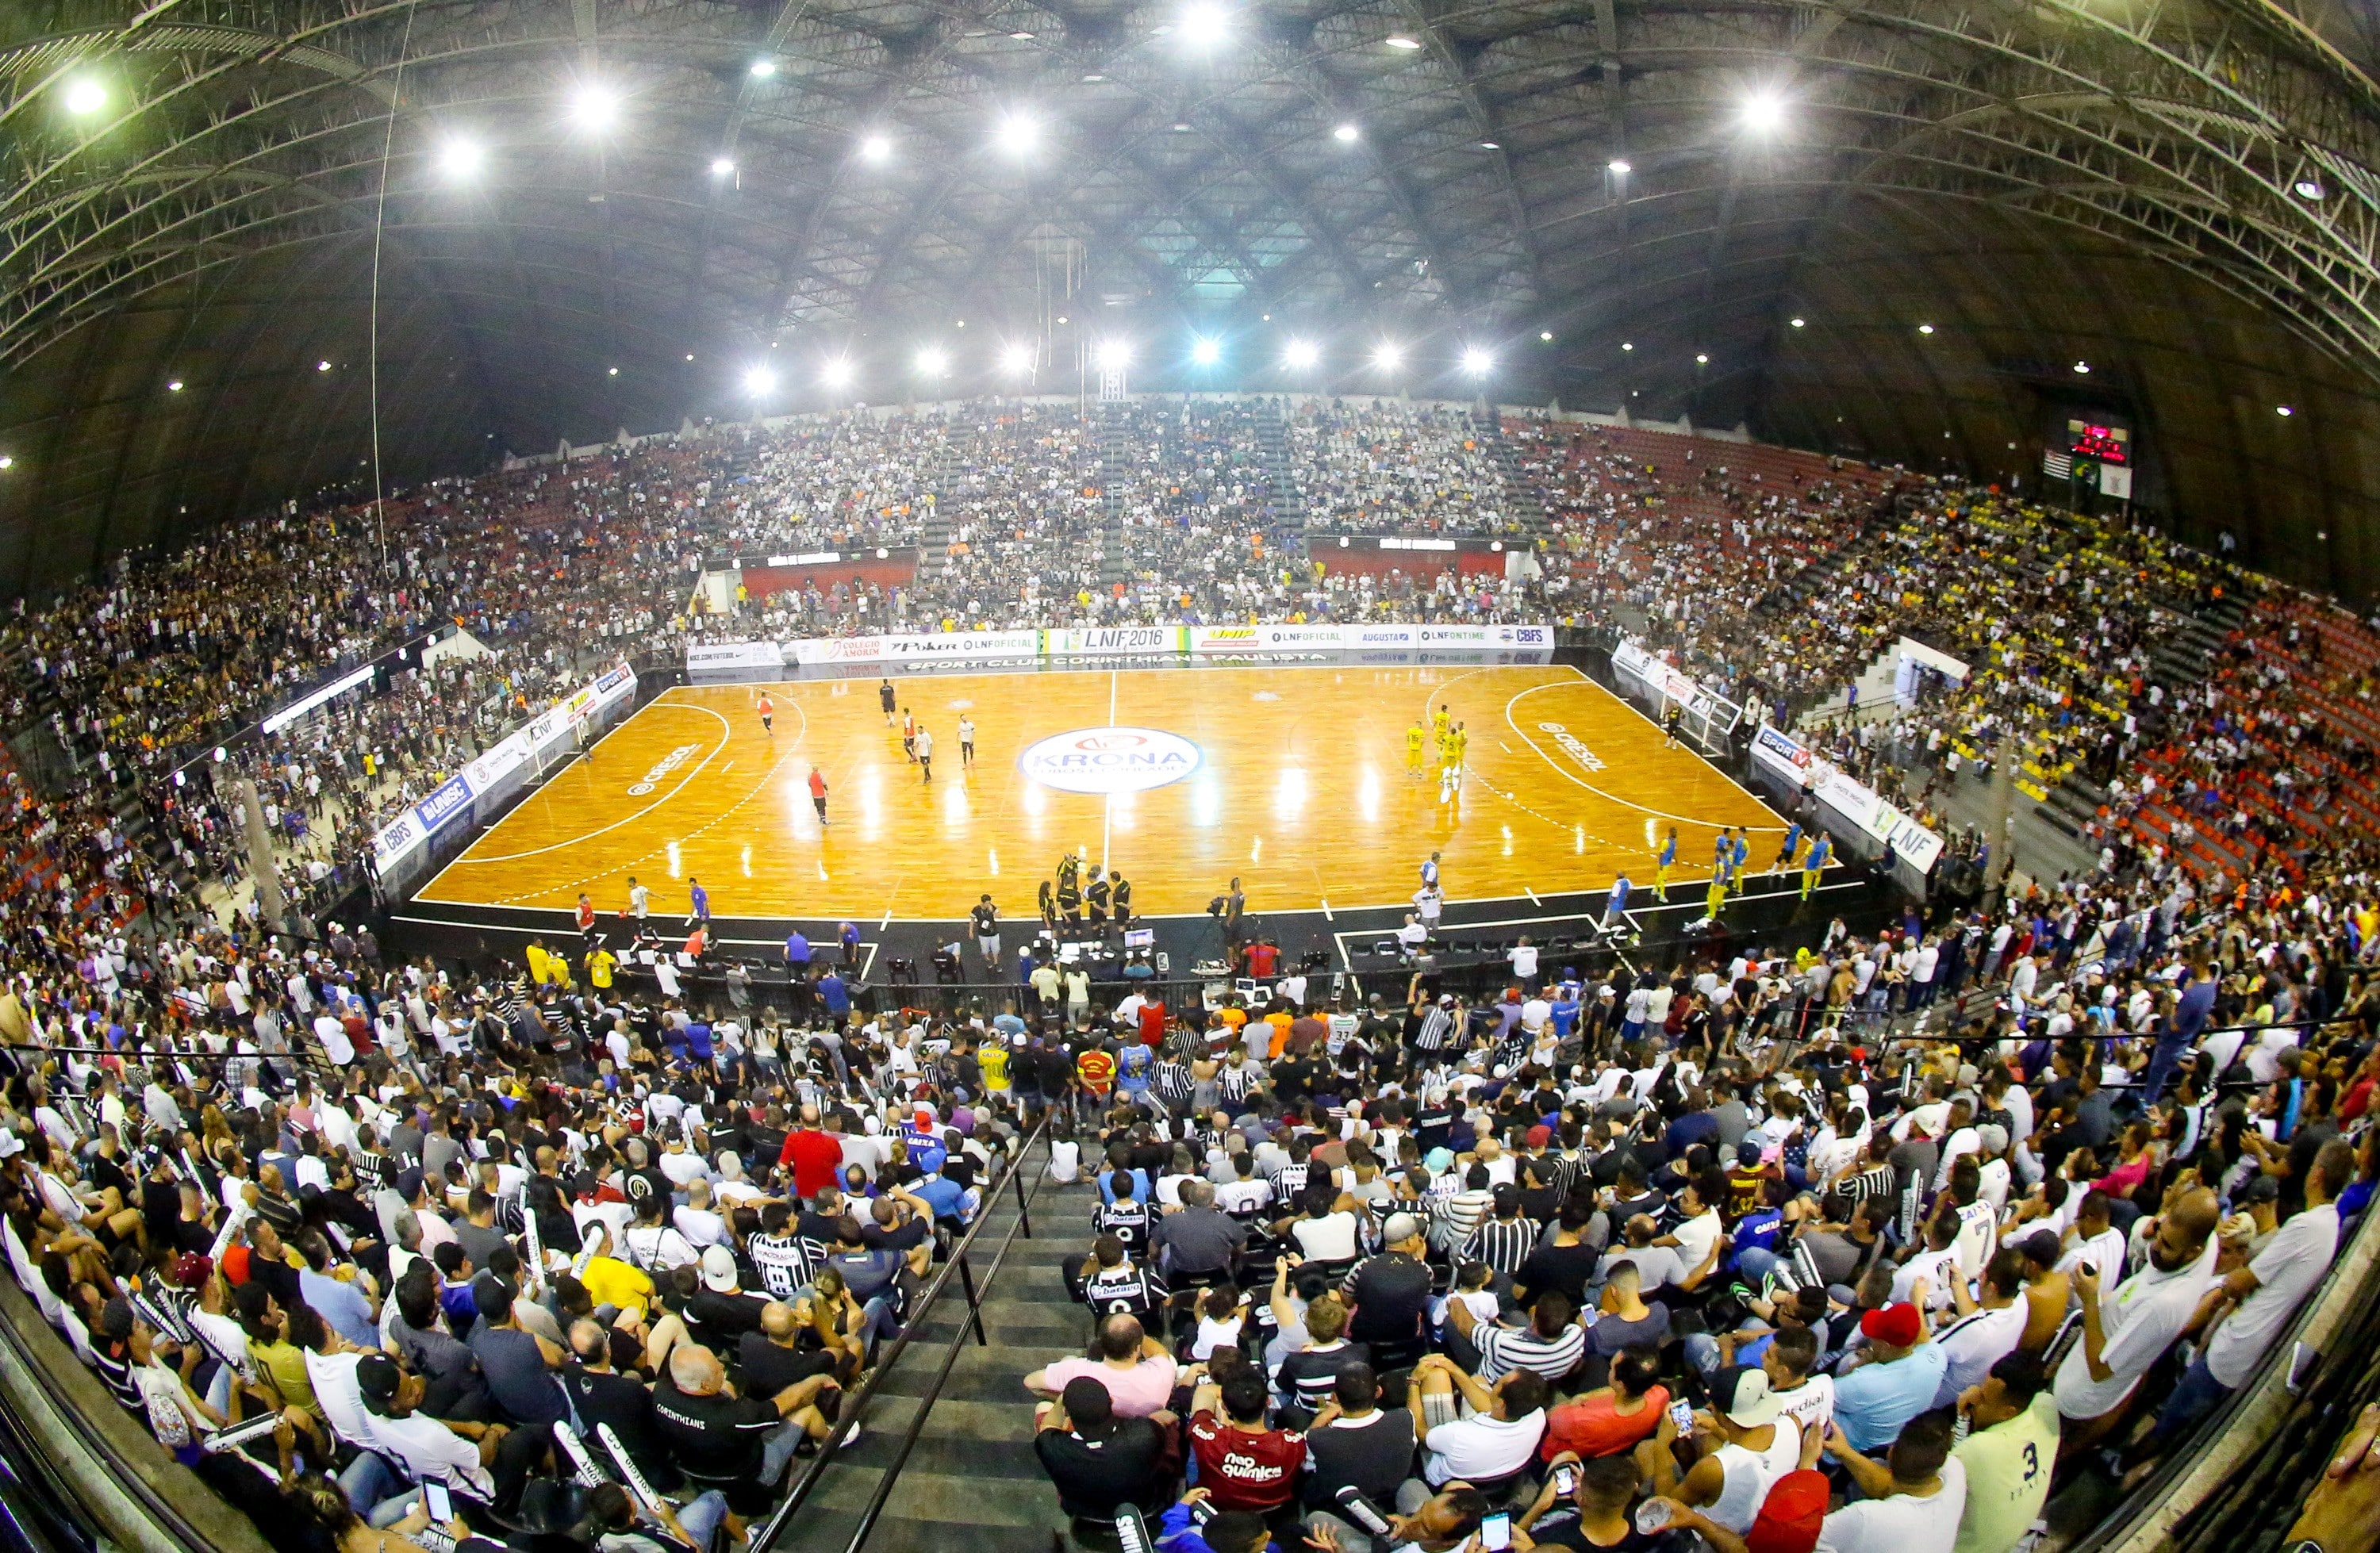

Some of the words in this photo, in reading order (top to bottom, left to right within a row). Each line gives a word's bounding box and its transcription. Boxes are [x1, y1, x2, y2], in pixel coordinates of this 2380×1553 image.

[1210, 629, 1256, 639] UNIP
[1283, 632, 1342, 642] LNFOFICIAL
[1361, 633, 1399, 642] AUGUSTA
[1431, 631, 1485, 640] LNFONTIME
[1516, 628, 1543, 642] CBFS
[843, 648, 881, 658] AMORIM
[907, 659, 981, 670] SPORT
[987, 658, 1046, 667] CLUB
[1052, 654, 1207, 665] CORINTHIANS
[1211, 653, 1328, 661] PAULISTA
[1761, 732, 1809, 765] SPORTV
[1033, 753, 1188, 767] KRONA
[384, 821, 412, 851] CBFS
[1887, 819, 1931, 856] LNF
[907, 1137, 936, 1148] CAIXA
[1113, 1214, 1145, 1222] batavo
[1974, 1218, 1992, 1265] 7
[1103, 1283, 1140, 1295] batavo
[656, 1402, 706, 1431] CORINTHIANS
[1223, 1451, 1256, 1468] neo
[2022, 1441, 2039, 1482] 3
